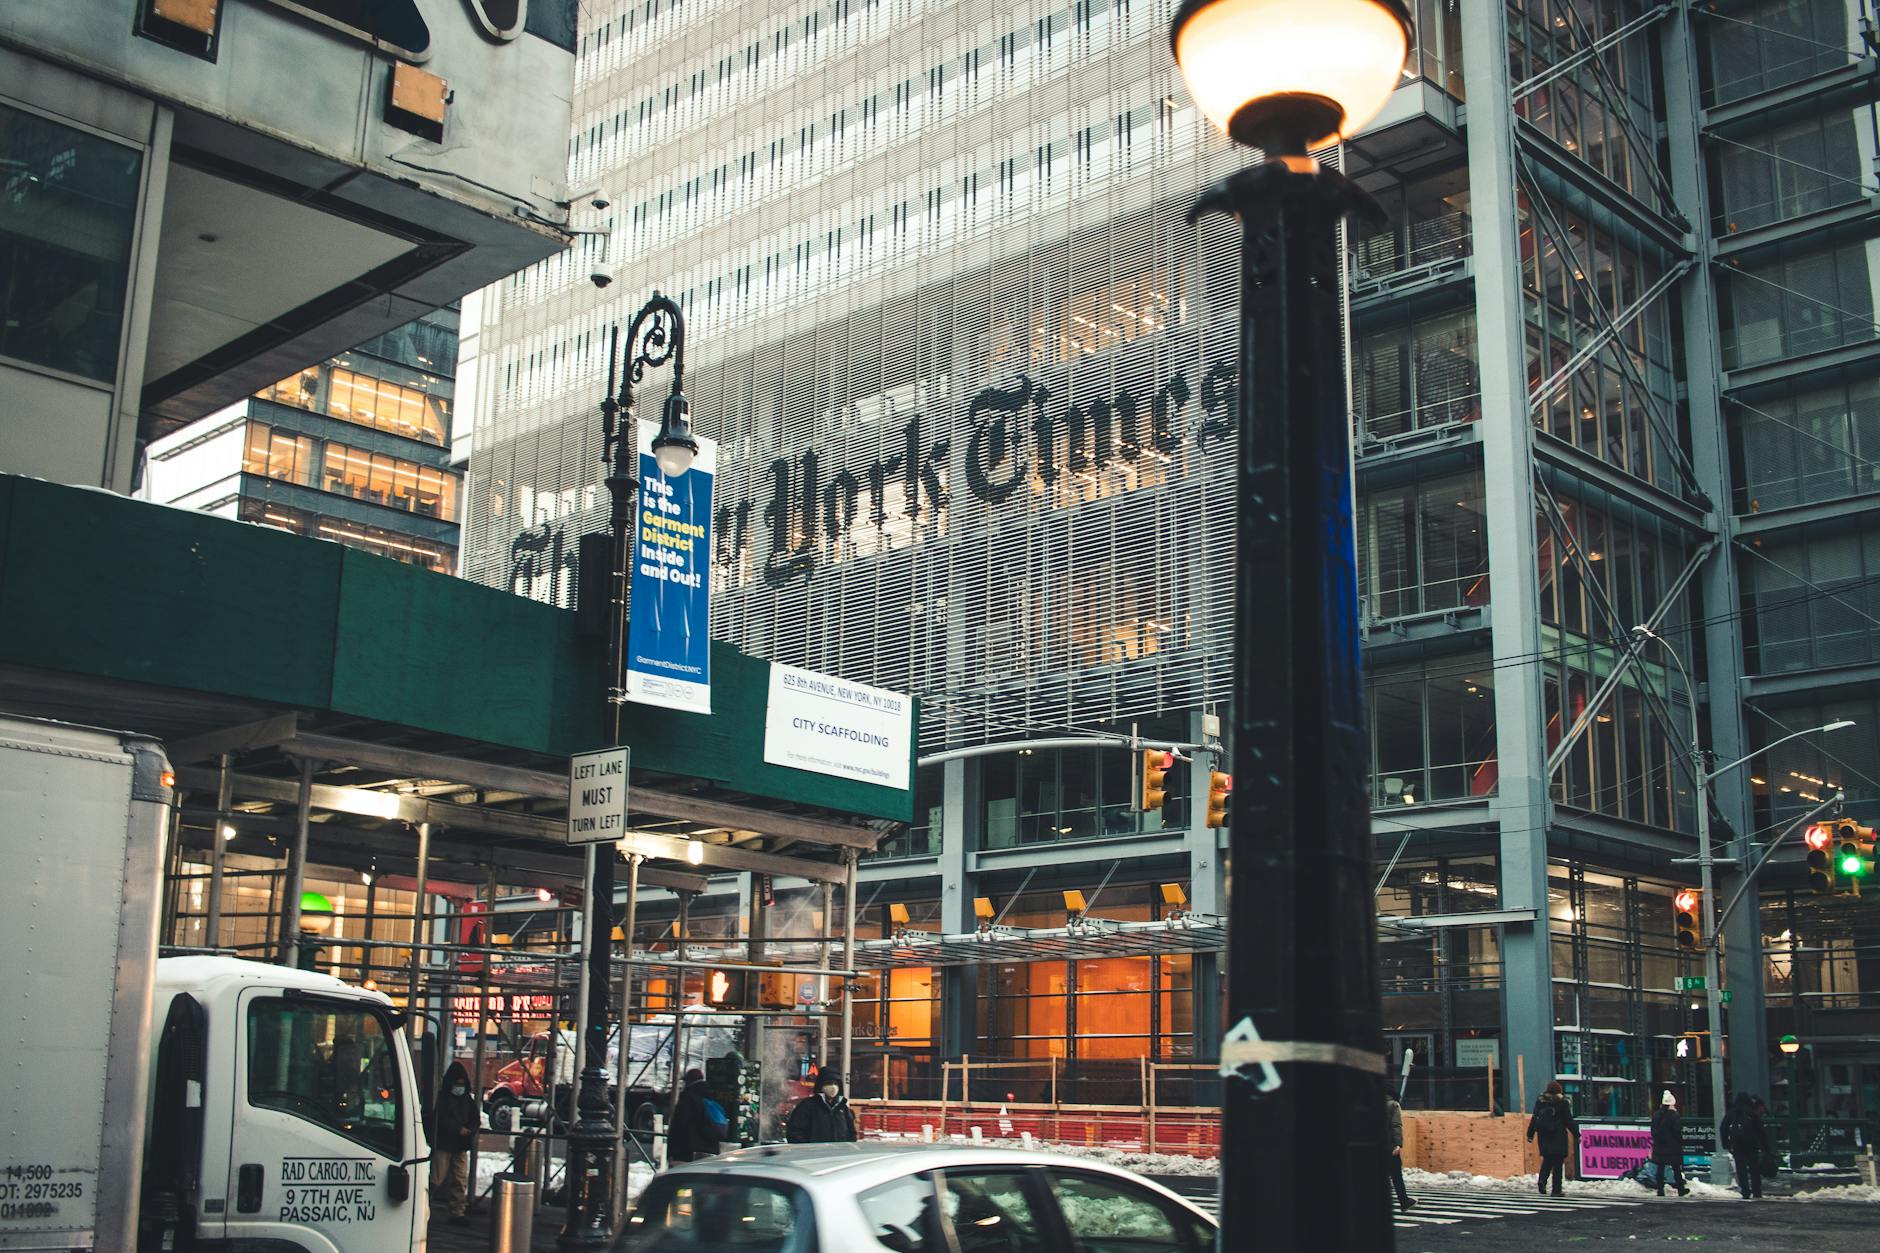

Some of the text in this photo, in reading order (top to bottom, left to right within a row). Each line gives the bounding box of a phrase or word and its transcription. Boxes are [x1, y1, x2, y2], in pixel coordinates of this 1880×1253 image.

[507, 523, 578, 604] Th
[765, 414, 950, 590] York
[968, 358, 1238, 503] Times
[643, 476, 674, 497] This
[643, 491, 681, 515] is the
[642, 511, 705, 539] Garment
[642, 527, 694, 552] District
[641, 544, 685, 567] Inside
[640, 563, 702, 589] and Out!
[783, 673, 902, 712] 625 8th AVENUE, NEW YORK, NY 10018
[792, 717, 889, 748] CITY SCAFFOLDING
[574, 760, 622, 780] LEFT LANE
[582, 786, 613, 807] MUST
[572, 814, 621, 833] TURN LEFT
[281, 1162, 376, 1182] RAD CARGO, INC.
[1585, 1155, 1598, 1168] LA
[6, 1164, 53, 1183] 14,500
[24, 1182, 83, 1199] 2975235
[286, 1189, 371, 1207] 9 7TH AVE.,
[279, 1205, 376, 1224] PASSAIC, NJ
